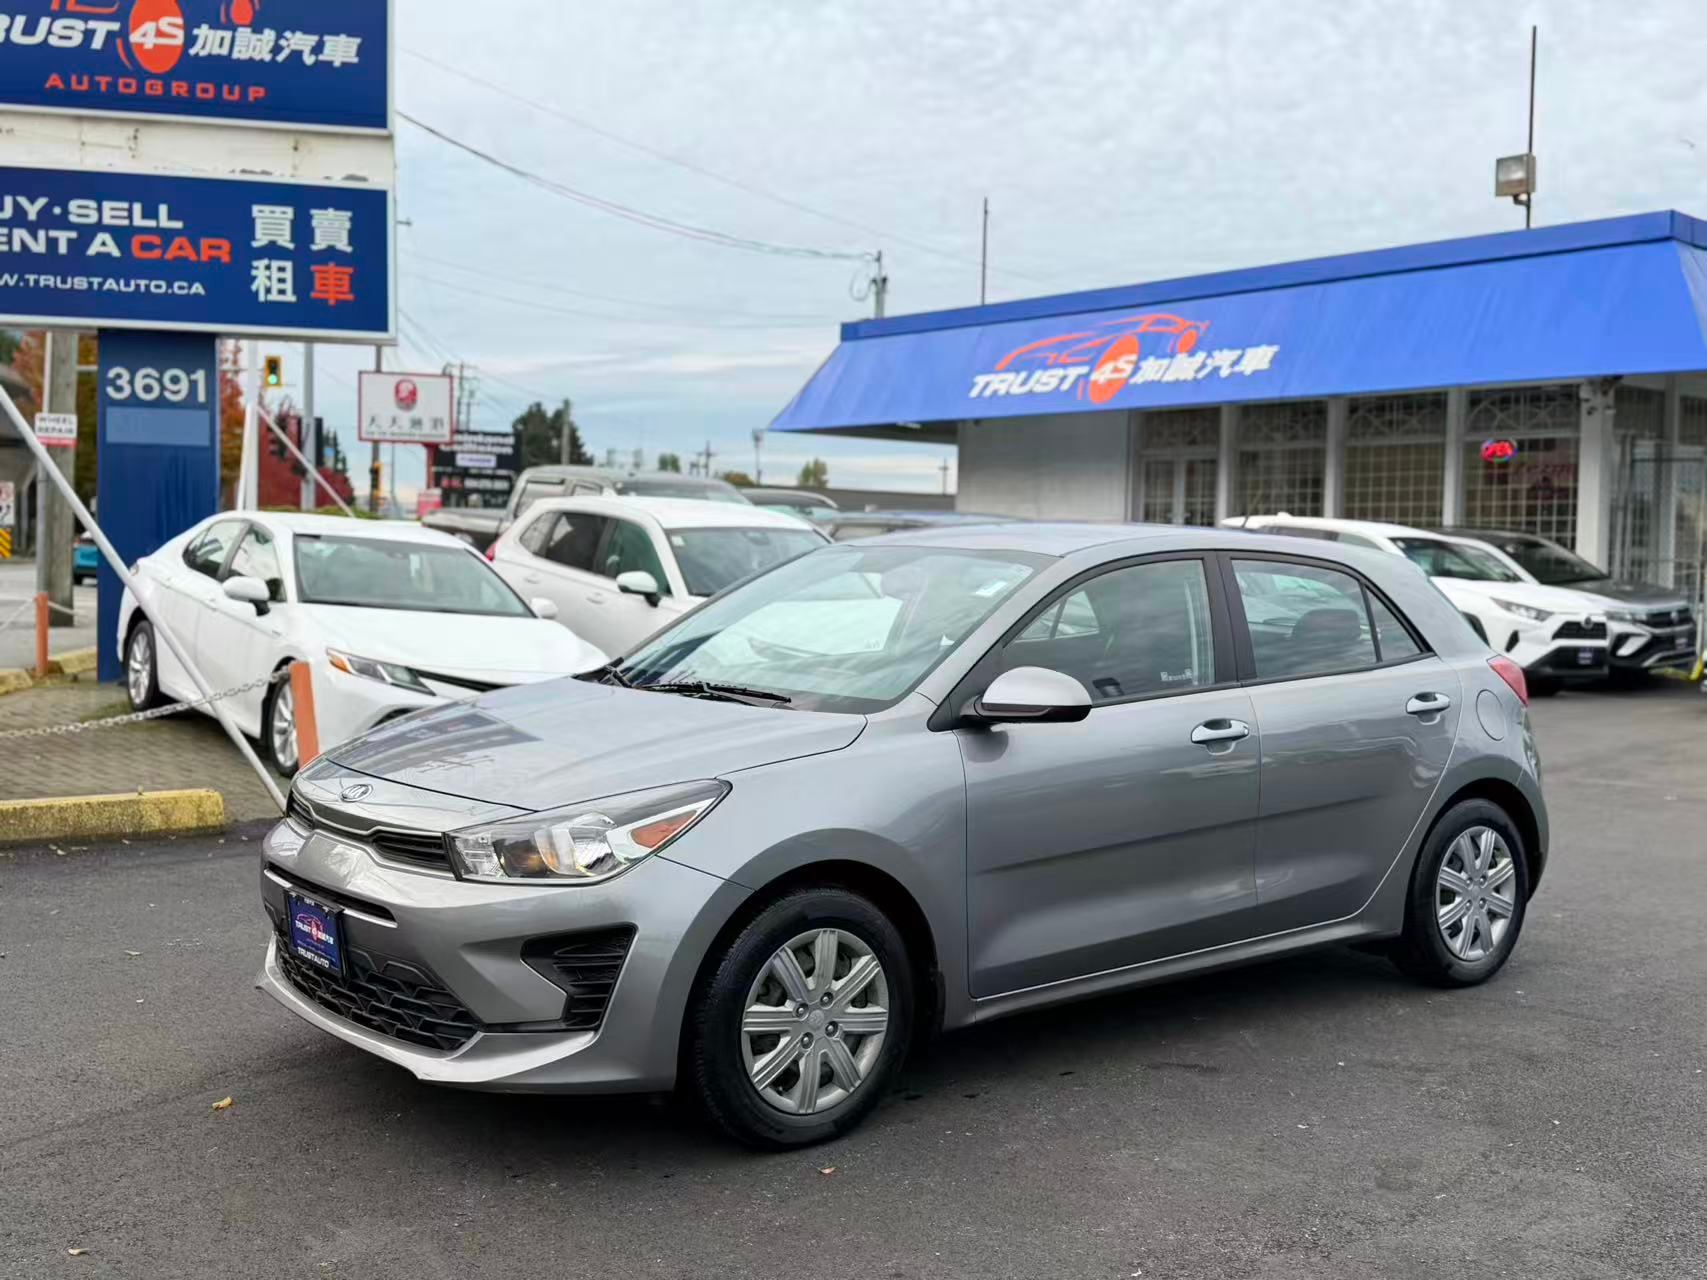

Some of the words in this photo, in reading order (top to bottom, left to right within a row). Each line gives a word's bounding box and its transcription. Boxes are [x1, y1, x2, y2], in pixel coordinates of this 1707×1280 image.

[0, 13, 121, 50] UST
[129, 16, 185, 49] 4S
[188, 24, 362, 67] 加誠汽車
[44, 72, 267, 102] AUTOGROUP
[86, 232, 121, 258] A
[131, 235, 232, 264] CAR
[106, 366, 207, 403] 3691
[968, 366, 1089, 398] TRUST
[1089, 354, 1138, 384] 4S
